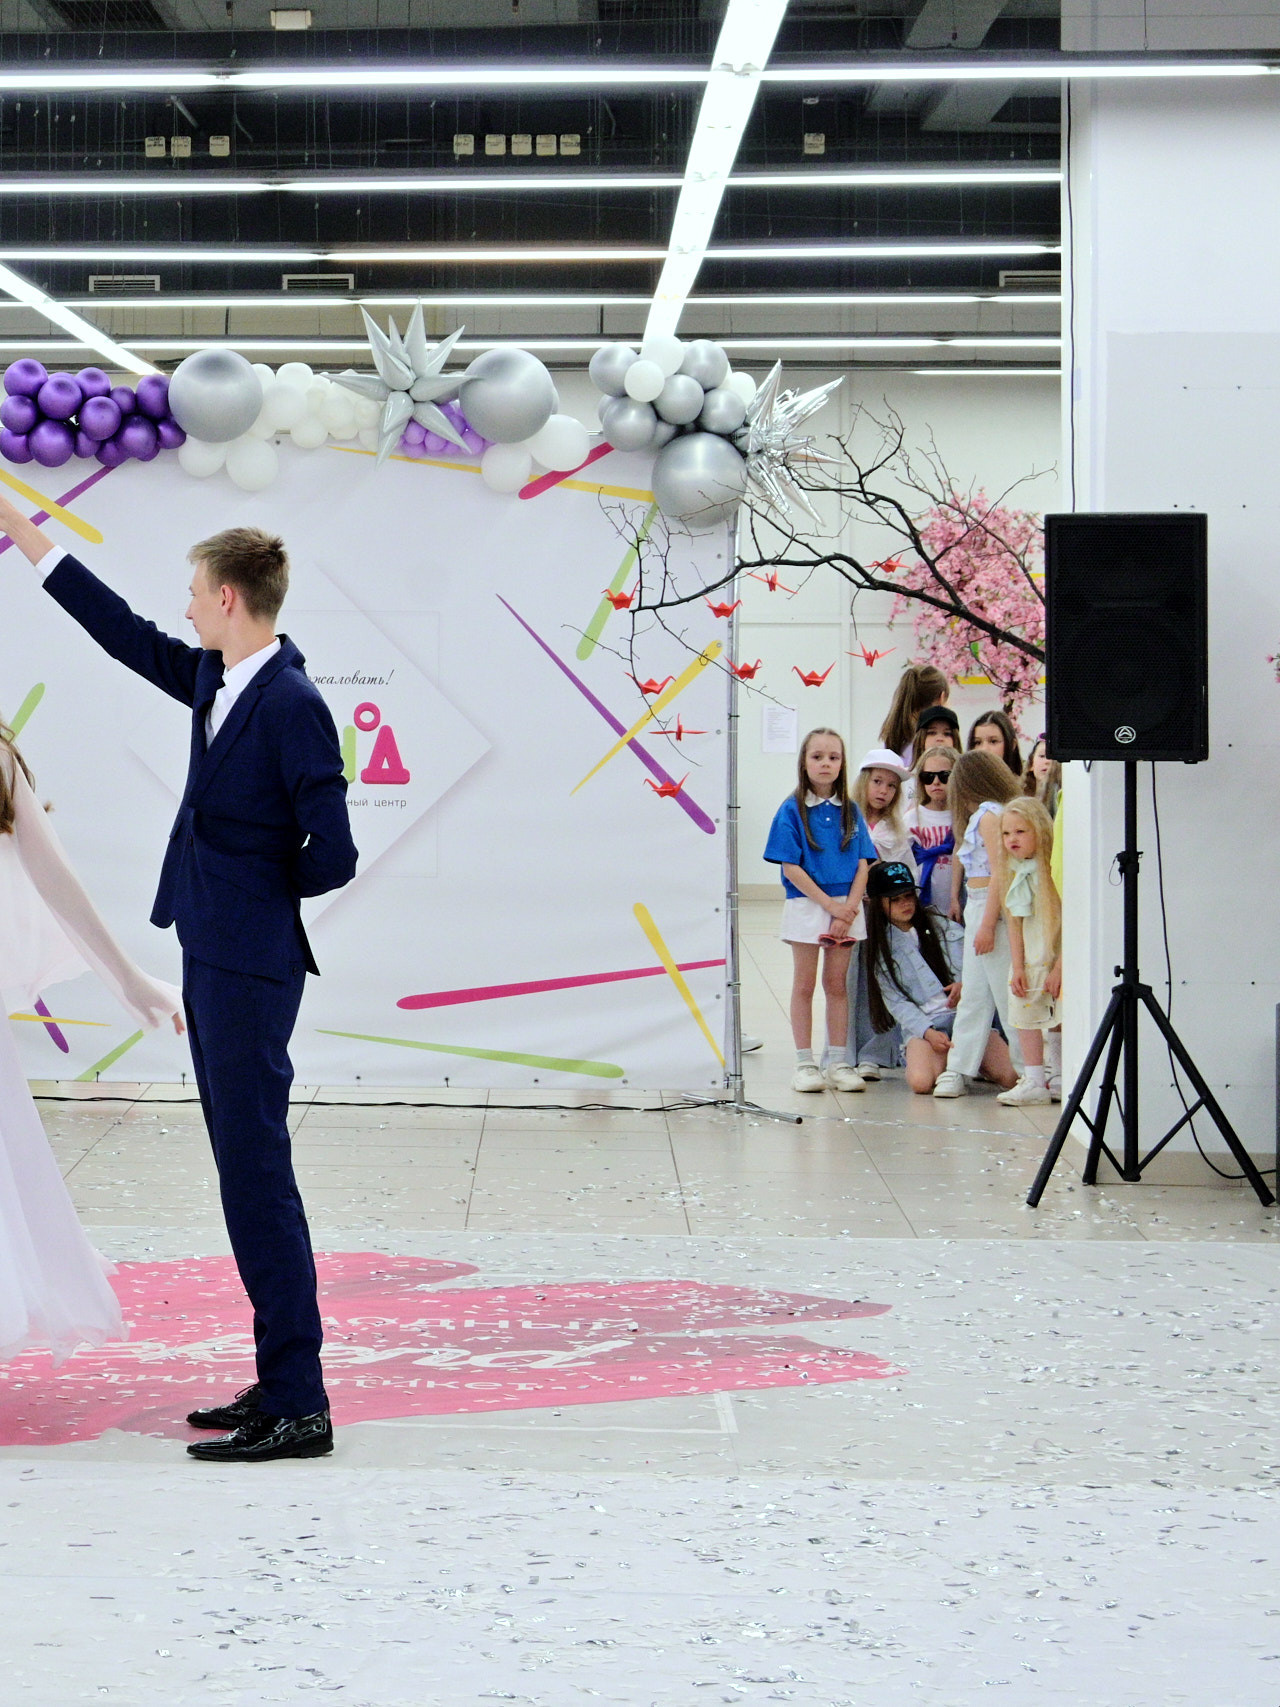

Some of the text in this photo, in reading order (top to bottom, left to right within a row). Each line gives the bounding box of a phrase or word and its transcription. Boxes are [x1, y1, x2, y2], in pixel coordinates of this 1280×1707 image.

[307, 669, 395, 686] ожаловать!
[347, 797, 407, 809] ный центр
